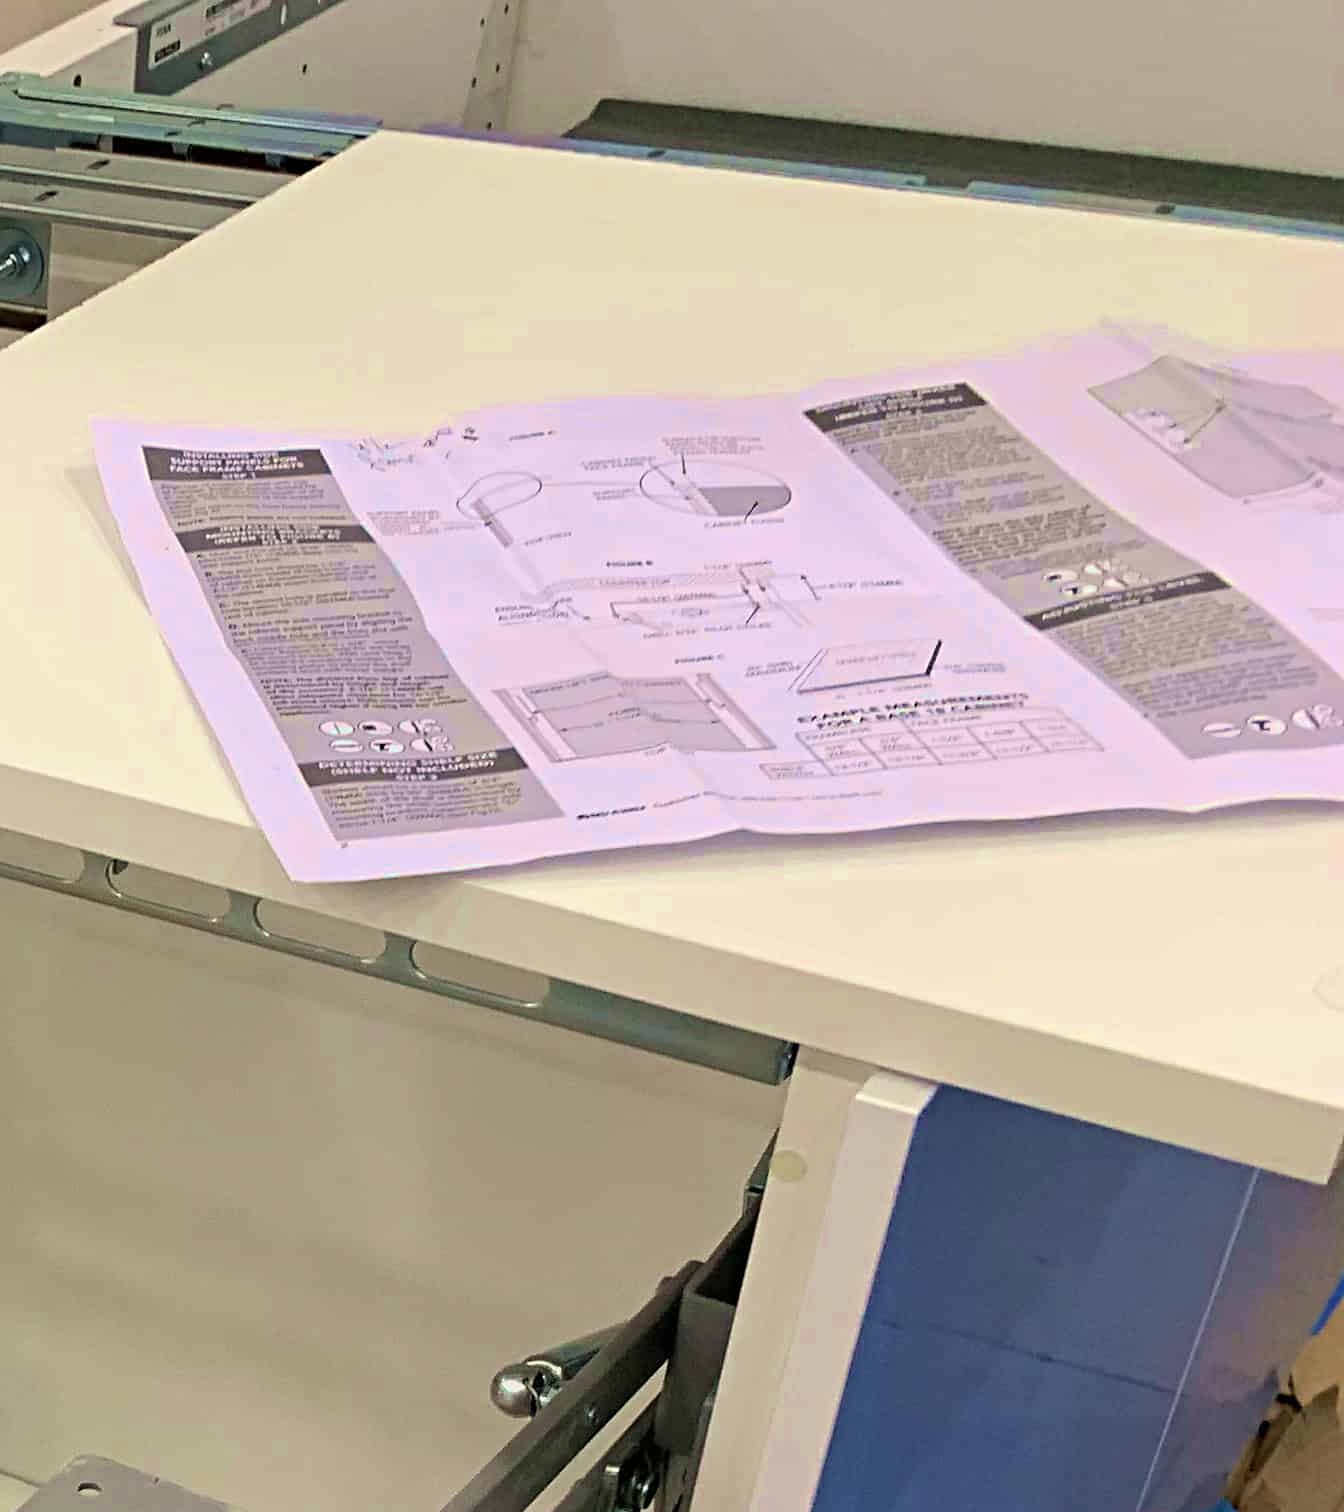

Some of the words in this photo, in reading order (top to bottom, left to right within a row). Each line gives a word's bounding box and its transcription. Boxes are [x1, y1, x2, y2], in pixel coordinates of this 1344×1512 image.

[170, 457, 221, 465] SUPPORT
[169, 464, 199, 473] FACE
[202, 464, 242, 472] FRAME
